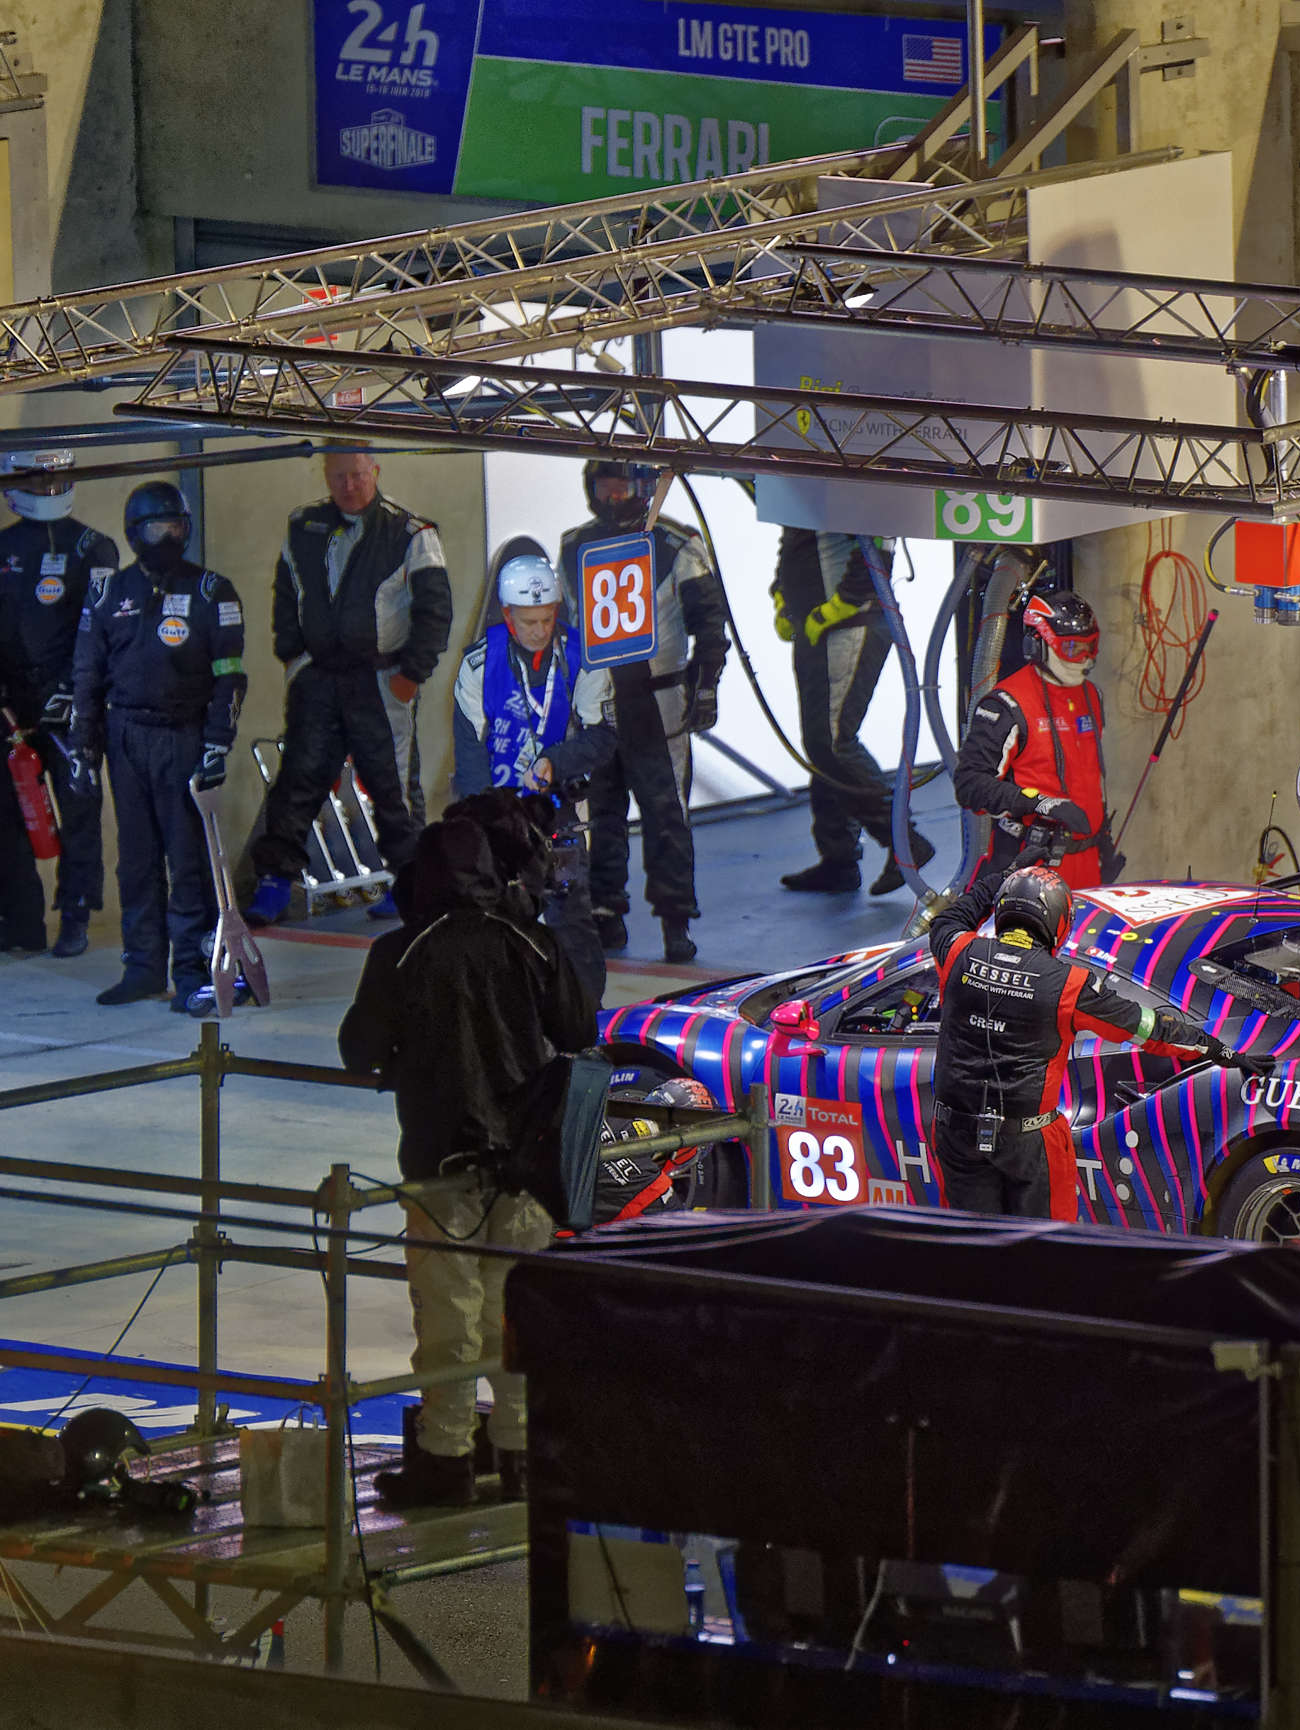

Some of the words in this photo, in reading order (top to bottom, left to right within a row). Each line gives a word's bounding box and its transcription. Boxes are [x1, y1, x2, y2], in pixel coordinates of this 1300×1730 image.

[339, 0, 440, 67] 24h
[677, 18, 713, 60] LM
[718, 23, 760, 65] GTE
[764, 27, 811, 68] PRO
[335, 62, 365, 82] LE
[367, 65, 433, 87] MANS
[341, 124, 436, 170] SUPERFINALE
[580, 105, 770, 182] FERRARI
[907, 425, 968, 441] ERRARI
[941, 489, 1027, 538] 89
[591, 562, 646, 639] 83
[968, 962, 1032, 989] KESSEL
[968, 1014, 1007, 1034] CREW
[777, 1098, 804, 1118] 24h
[808, 1106, 859, 1126] TOTAL
[788, 1131, 860, 1202] 83
